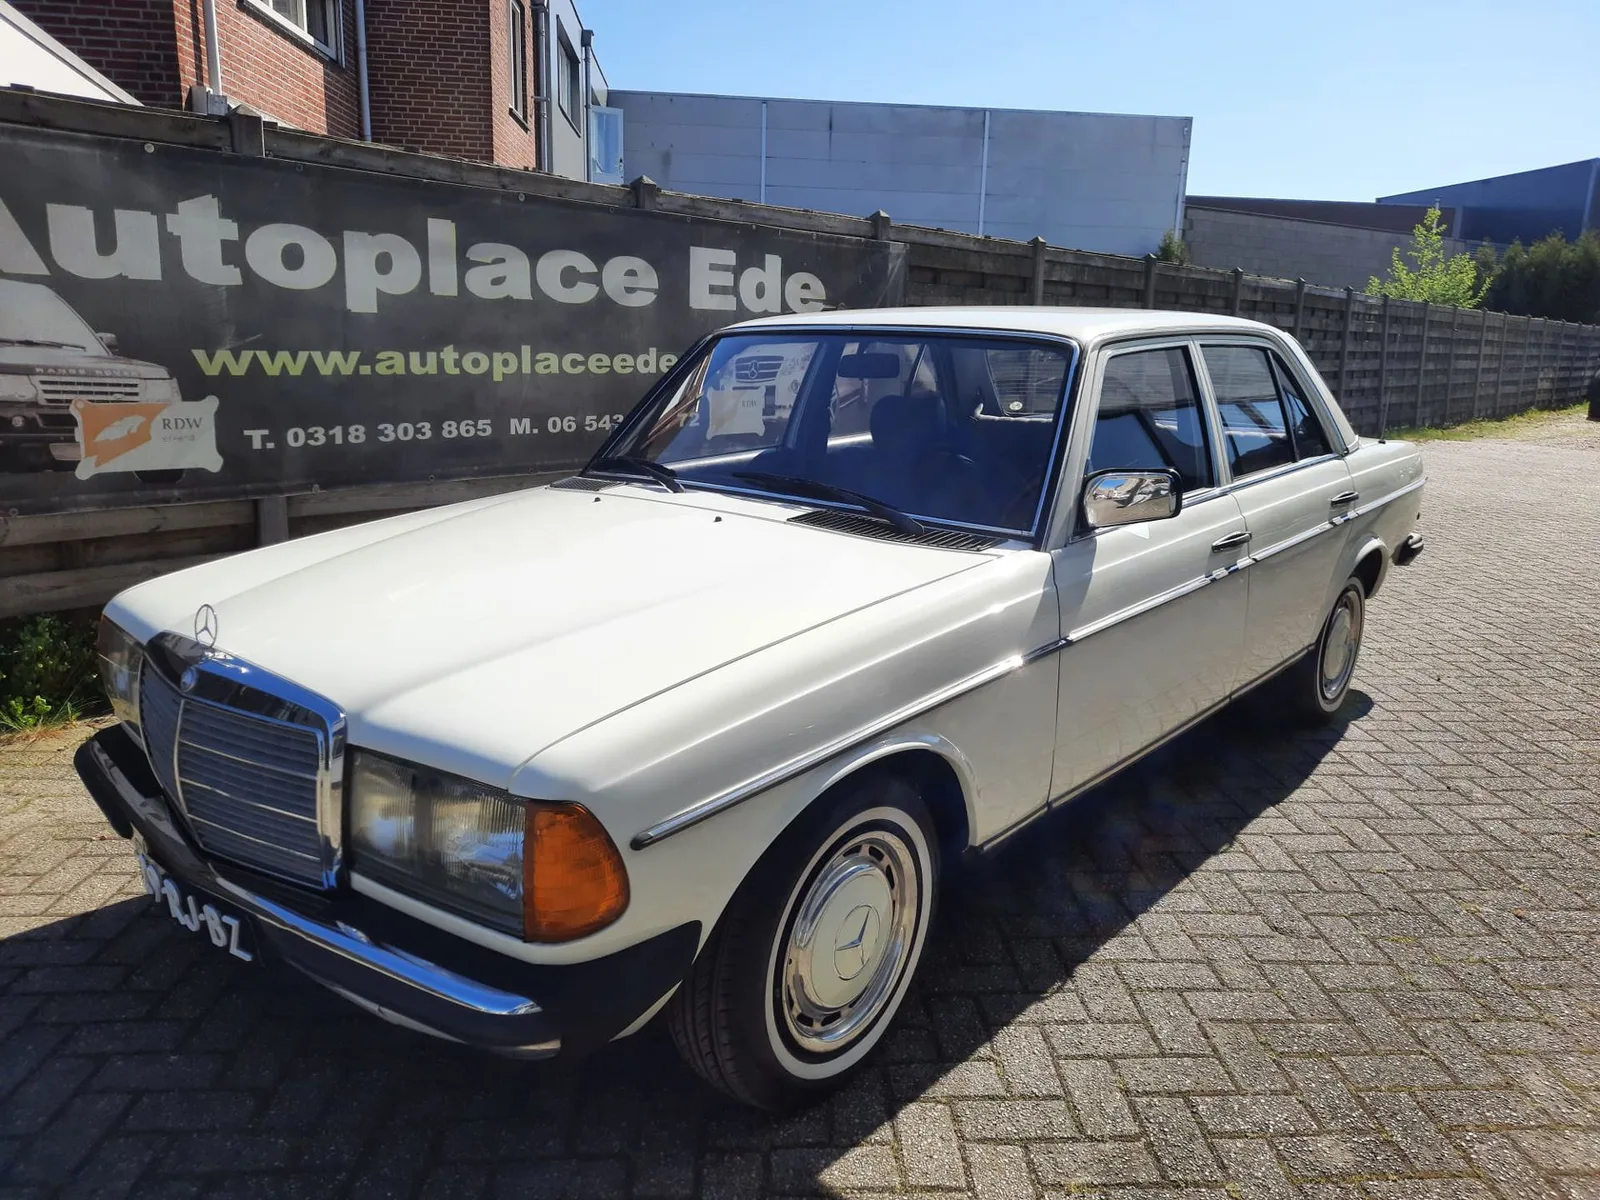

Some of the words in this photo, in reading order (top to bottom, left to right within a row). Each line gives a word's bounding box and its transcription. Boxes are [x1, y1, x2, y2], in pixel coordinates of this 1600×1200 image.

[689, 246, 827, 313] Ede
[162, 417, 202, 430] RDW
[243, 429, 275, 450] T.
[286, 426, 366, 447] 0318
[377, 423, 432, 443] 303
[441, 419, 492, 439] 865
[509, 418, 538, 435] M.
[547, 416, 577, 433] 06
